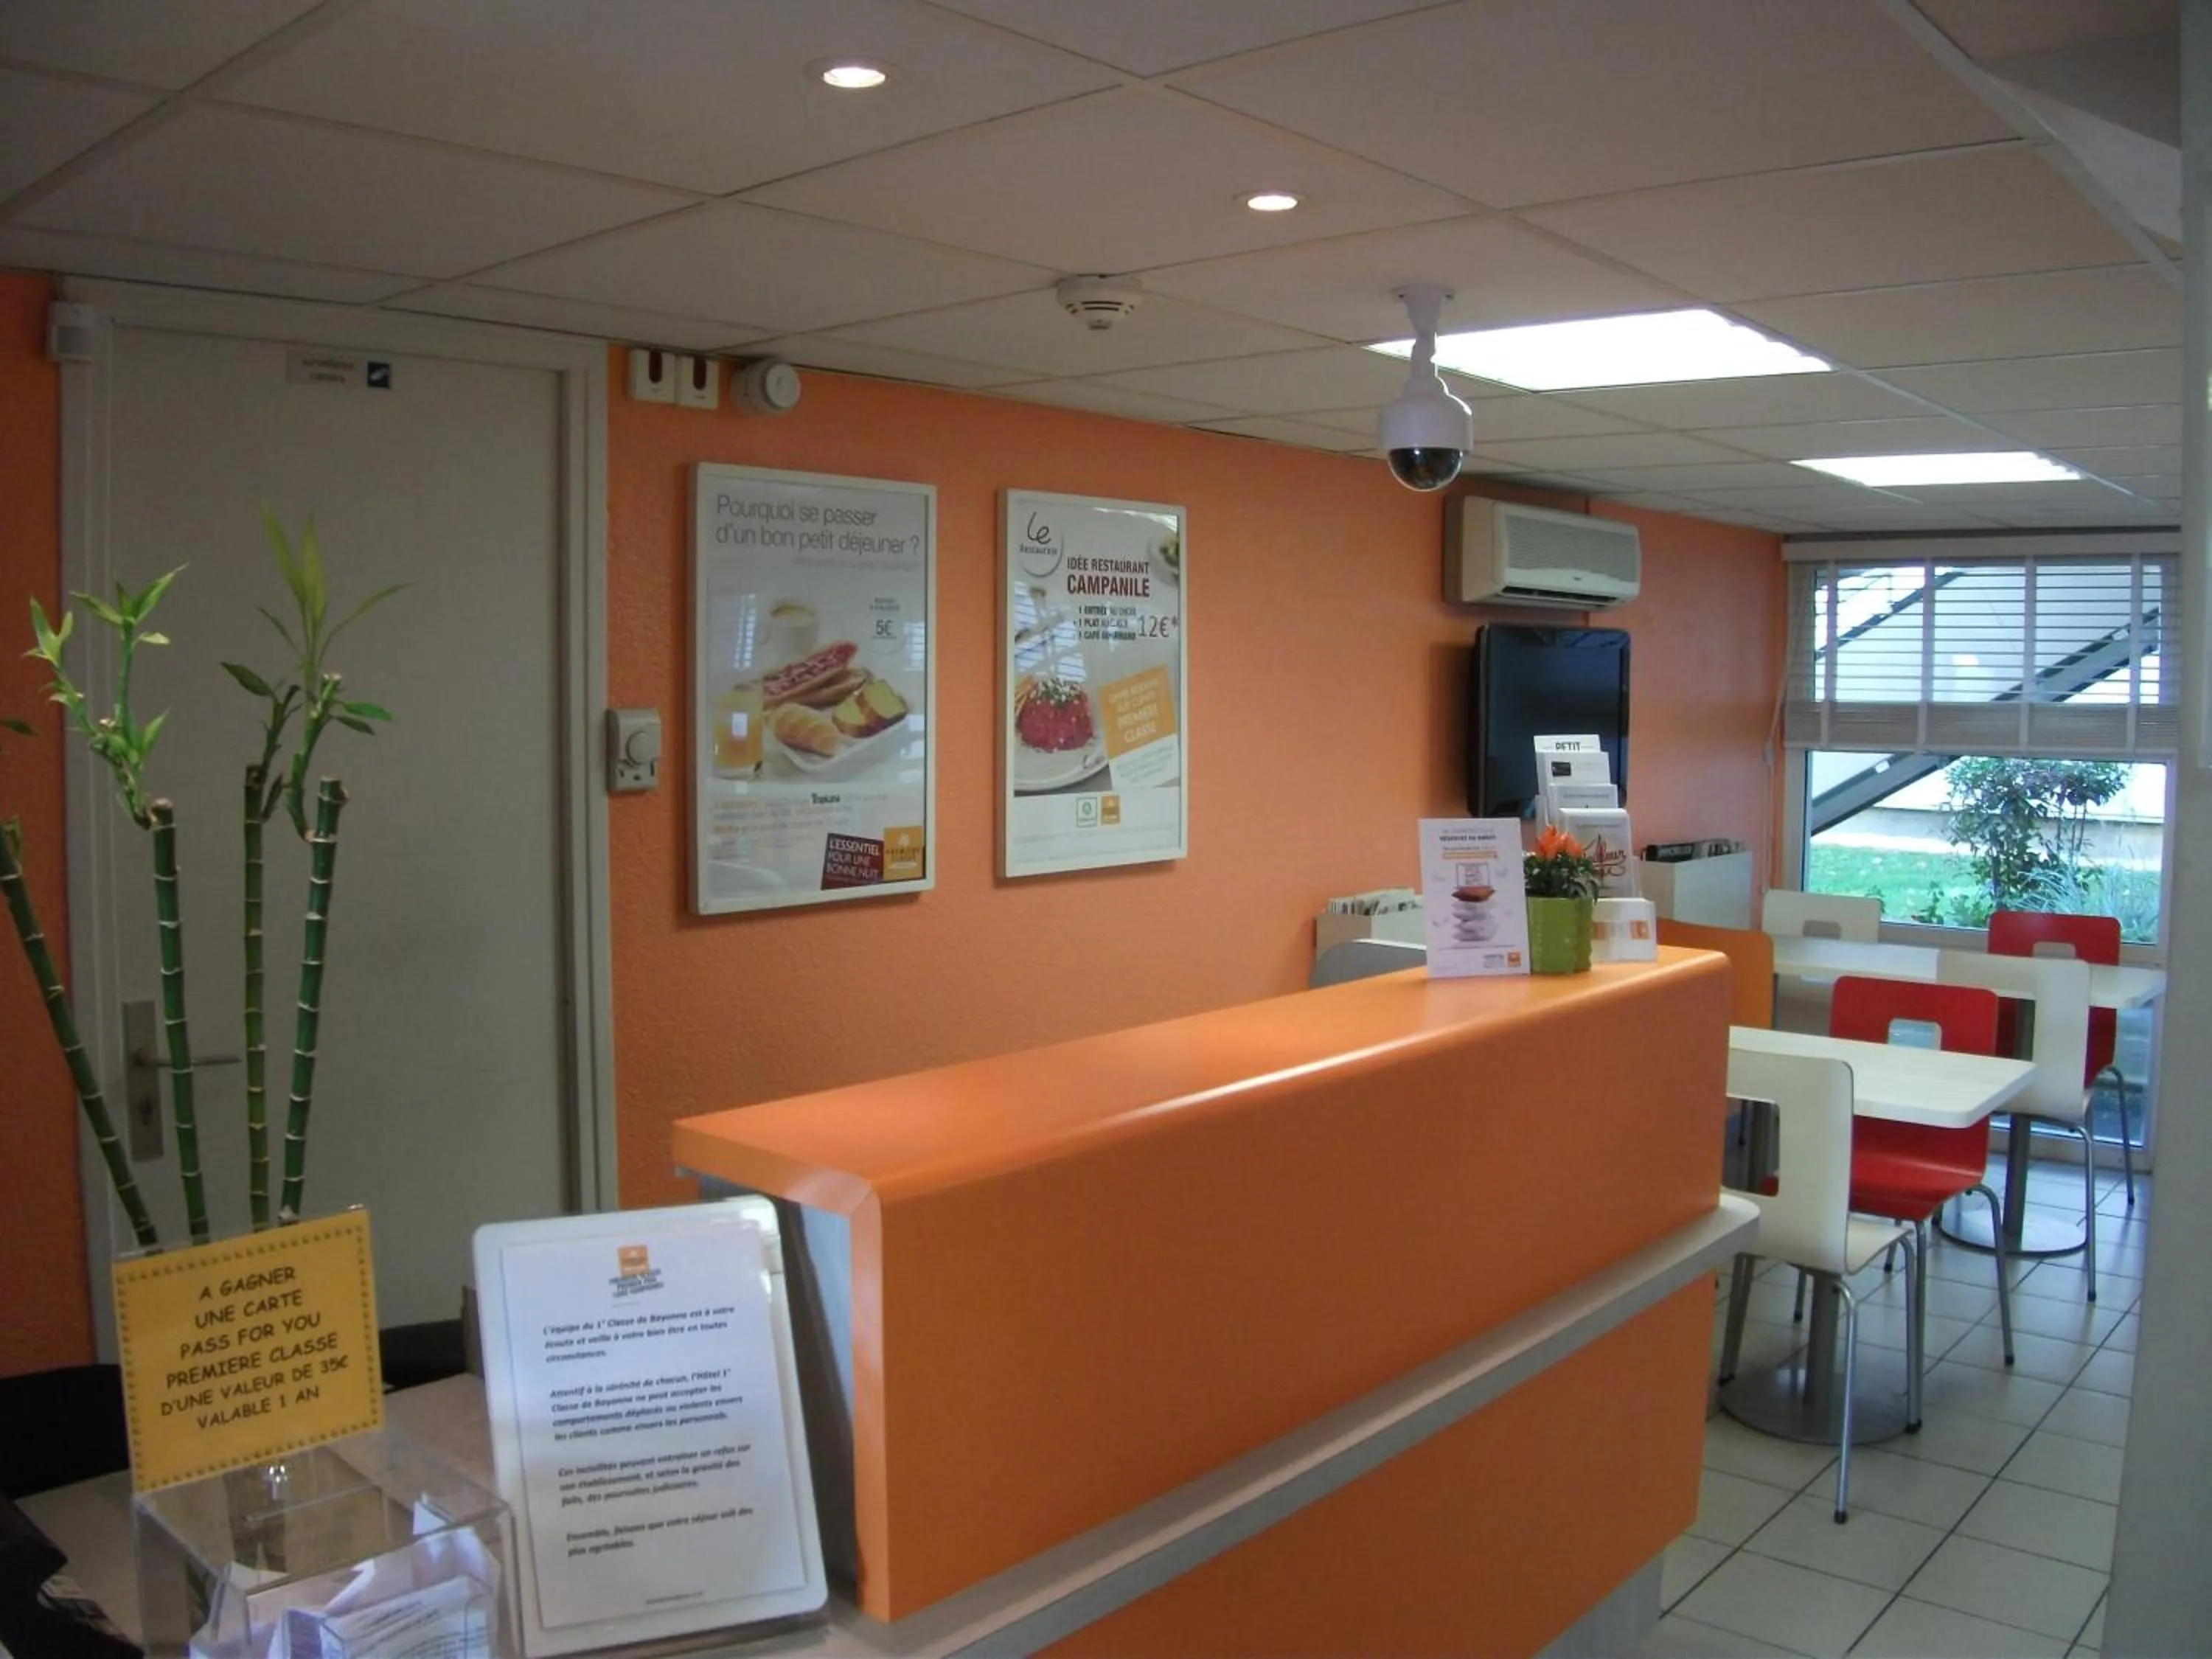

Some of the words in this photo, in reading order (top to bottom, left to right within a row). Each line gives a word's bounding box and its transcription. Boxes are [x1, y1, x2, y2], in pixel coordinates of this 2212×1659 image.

[717, 495, 794, 521] Pourquoi
[799, 507, 818, 521] se
[824, 509, 877, 526] passer
[715, 522, 756, 544] d'un
[761, 526, 794, 547] bon
[799, 529, 833, 550] petit
[838, 532, 905, 554] déjeuner
[1067, 555, 1089, 571] IDÉE
[1091, 558, 1150, 574] RESTAURANT
[1067, 574, 1150, 598] CAMPANILE
[830, 838, 880, 856] L'ESSENTIEL
[199, 1286, 211, 1301] A
[220, 1266, 296, 1296] GAGNER
[195, 1305, 235, 1329] UNE
[243, 1290, 303, 1318] CARTE
[607, 1318, 634, 1328] Classe
[637, 1315, 647, 1324] de
[712, 1307, 734, 1315] votre
[180, 1333, 231, 1360] PASS
[237, 1324, 274, 1346] FOR
[282, 1312, 321, 1334] YOU
[576, 1337, 585, 1345] et
[622, 1329, 644, 1340] votre
[700, 1322, 728, 1331] toutes
[167, 1352, 262, 1389] PREMIERE
[269, 1332, 338, 1364] CLASSE
[161, 1390, 214, 1416] D'UNE
[220, 1372, 285, 1400] VALEUR
[292, 1363, 313, 1382] DE
[642, 1378, 653, 1387] de
[197, 1397, 272, 1429] VALABLE
[280, 1396, 285, 1408] 1
[296, 1387, 319, 1403] AN
[552, 1403, 578, 1413] Classe
[582, 1401, 592, 1410] de
